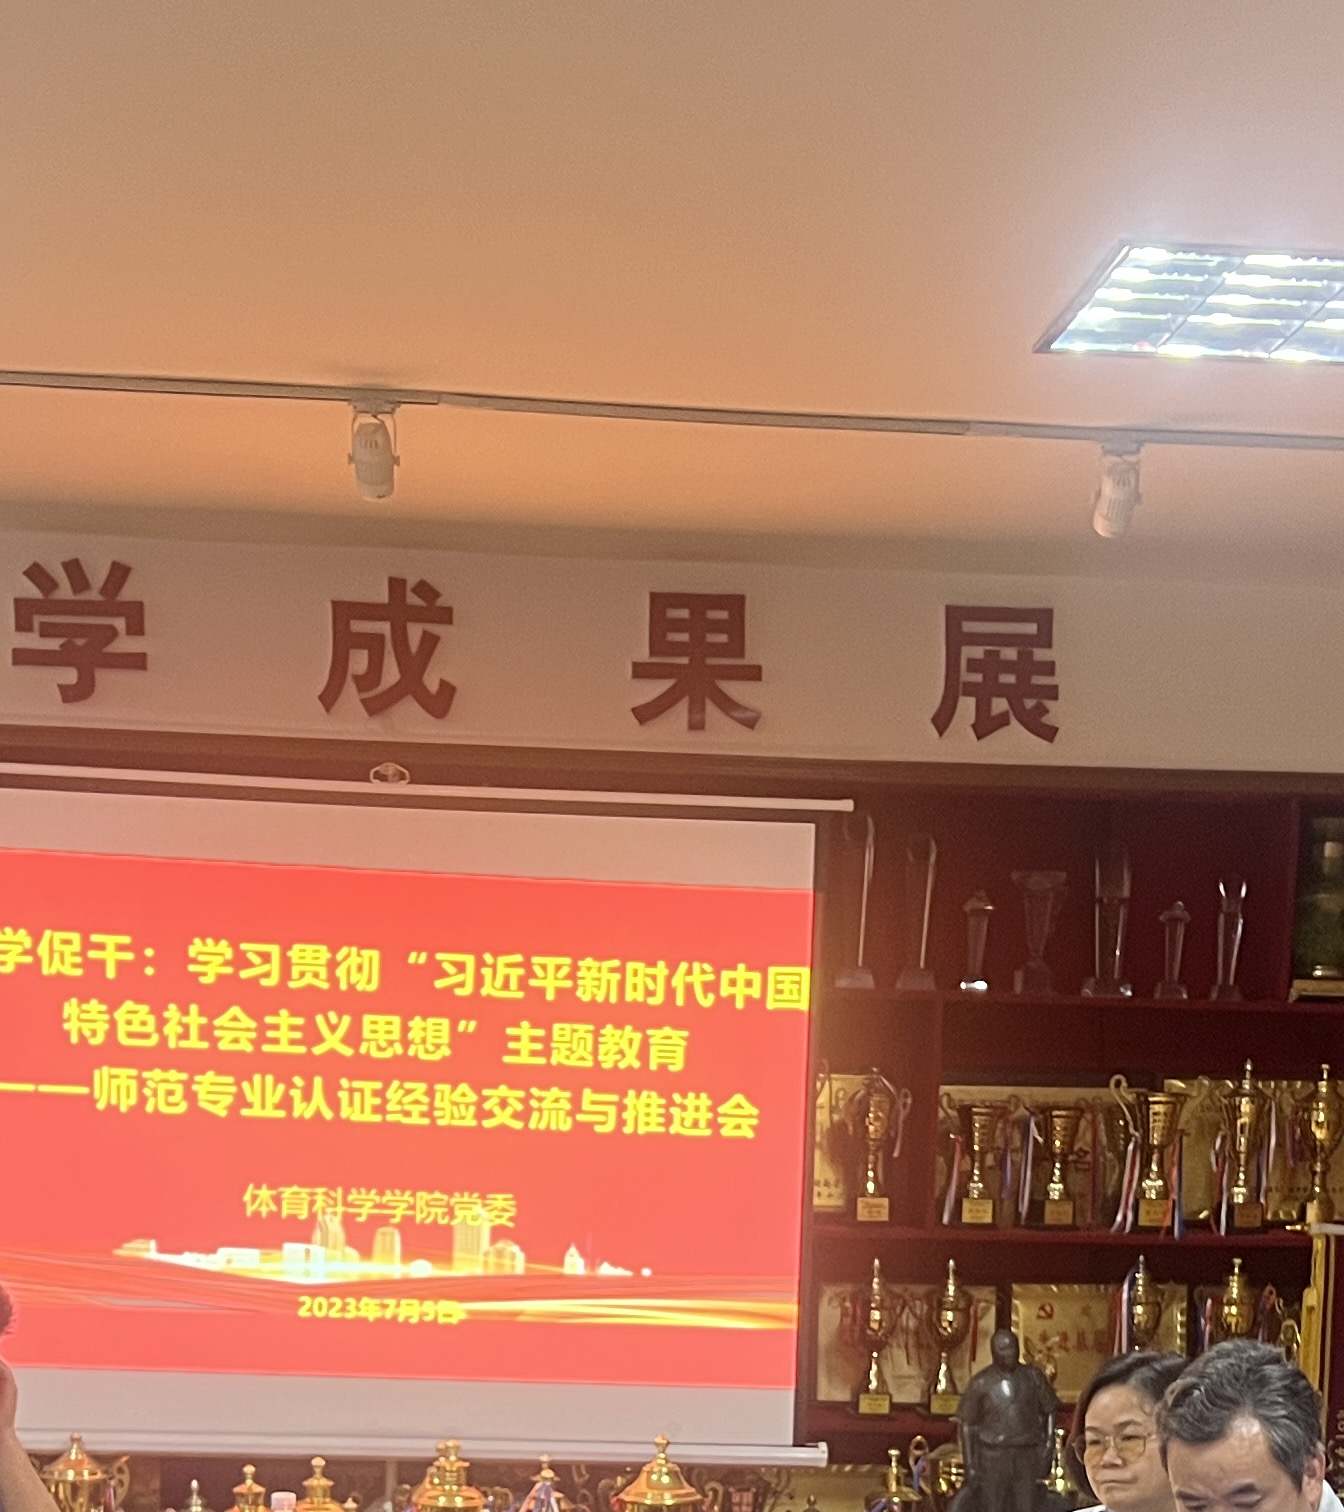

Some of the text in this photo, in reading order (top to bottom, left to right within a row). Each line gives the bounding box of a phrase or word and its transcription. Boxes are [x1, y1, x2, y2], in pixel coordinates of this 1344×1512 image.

[62, 997, 689, 1073] 特色社会主义思想”主题教育
[243, 1183, 517, 1228] 体育科学学院党委
